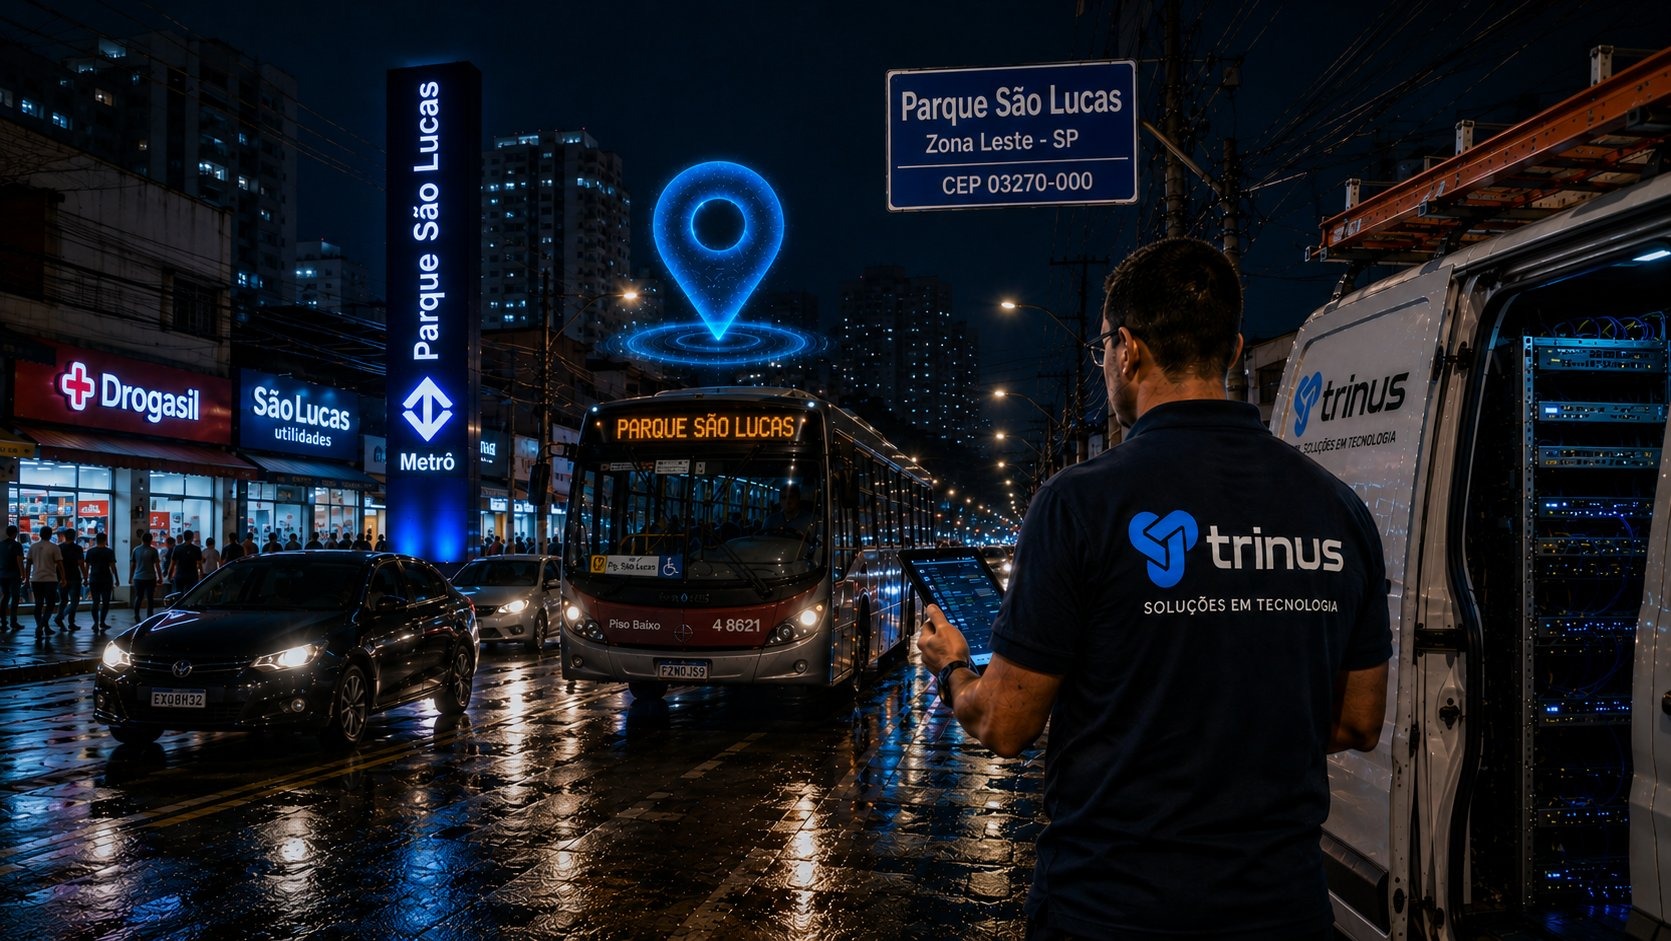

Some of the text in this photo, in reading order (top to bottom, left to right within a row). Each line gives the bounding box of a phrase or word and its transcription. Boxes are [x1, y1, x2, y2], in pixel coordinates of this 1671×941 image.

[901, 84, 1122, 126] Parque São Lucas
[925, 133, 974, 154] Zona
[980, 131, 1033, 151] Leste
[1052, 129, 1079, 148] SP
[942, 171, 1093, 195] CEP 03270-000
[413, 81, 446, 360] Parque São Lucas
[101, 372, 199, 424] Drogasil
[253, 385, 351, 431] São Lucas
[1321, 371, 1410, 422] trinus
[274, 426, 332, 447] utilidades
[617, 412, 794, 440] PARQUE SÃO LUCAS
[1336, 438, 1348, 451] EM
[1348, 430, 1396, 449] TECNOLOGIA
[399, 451, 456, 471] Metrô
[1206, 525, 1345, 573] trinus
[1144, 596, 1339, 616] SOLUÇÕES EM TECNOLOGIA
[608, 619, 662, 631] Piso Baixo
[712, 618, 761, 632] 4 8621
